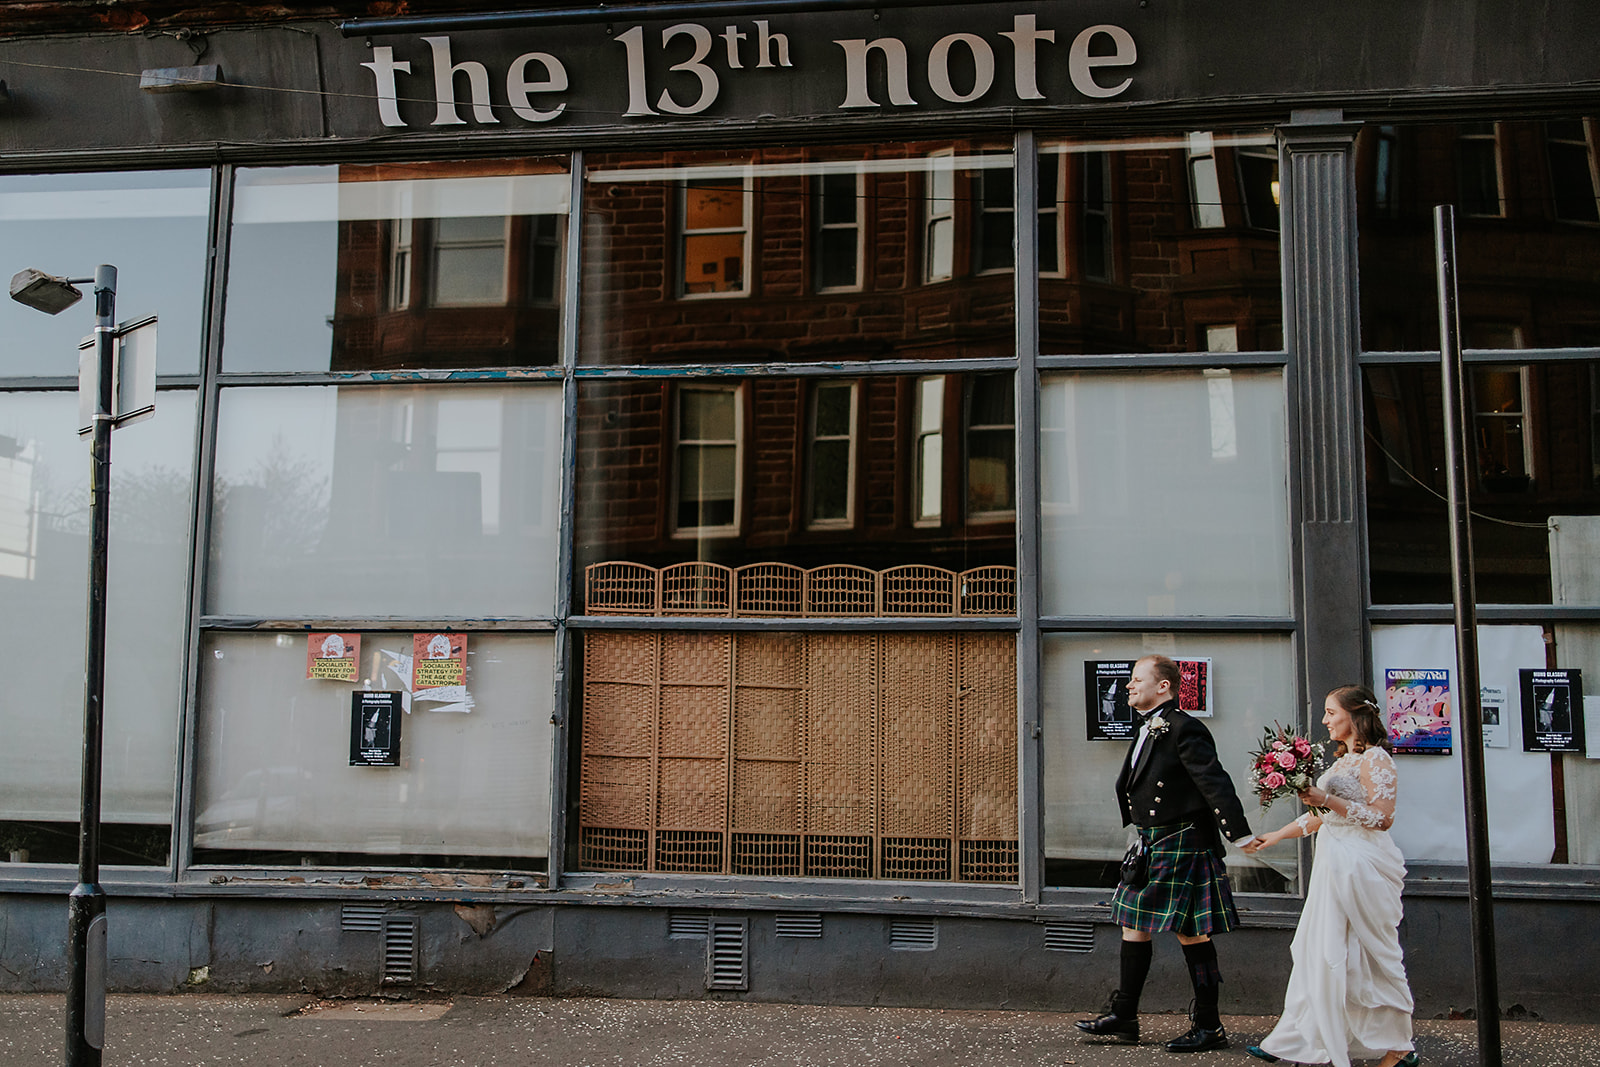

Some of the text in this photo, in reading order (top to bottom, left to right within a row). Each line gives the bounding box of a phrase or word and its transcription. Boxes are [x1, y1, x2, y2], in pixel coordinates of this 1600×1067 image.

[360, 14, 1137, 127] the 13th note
